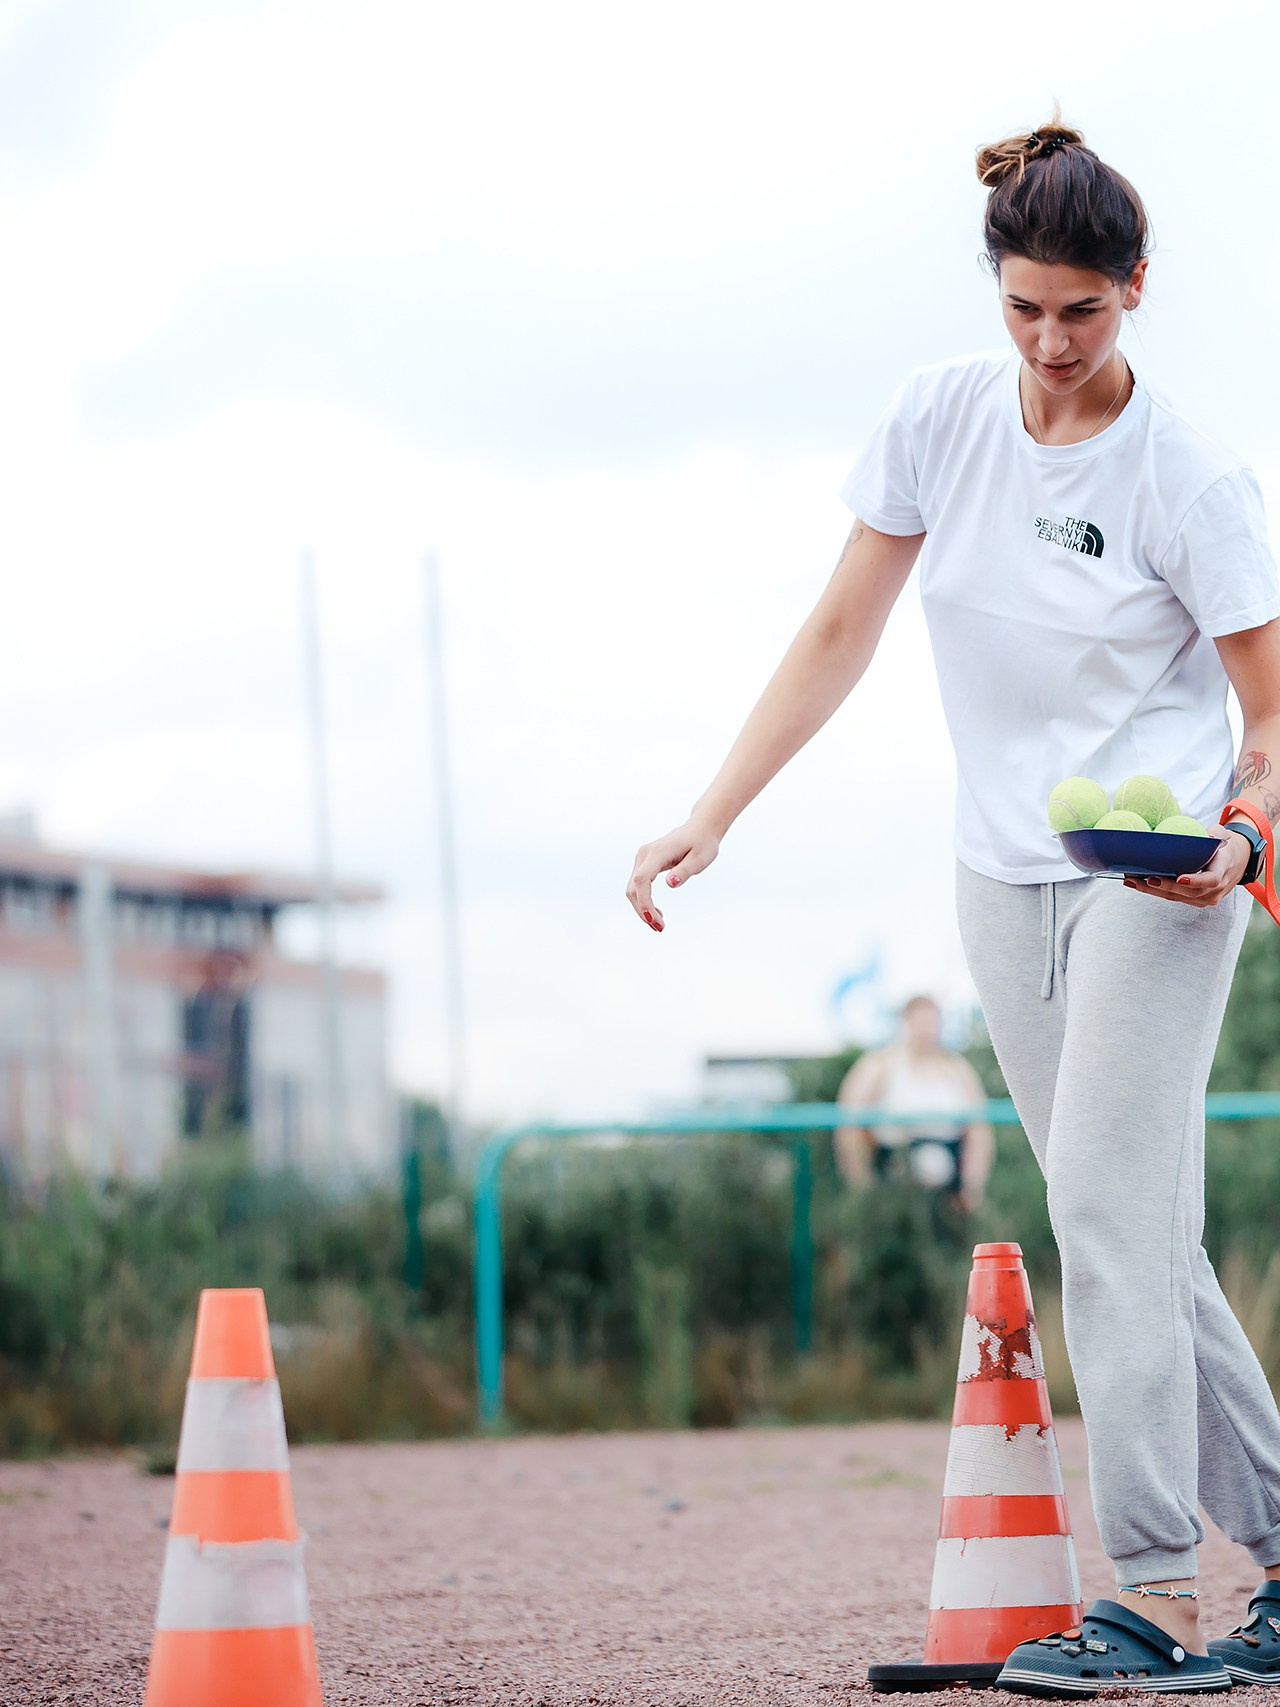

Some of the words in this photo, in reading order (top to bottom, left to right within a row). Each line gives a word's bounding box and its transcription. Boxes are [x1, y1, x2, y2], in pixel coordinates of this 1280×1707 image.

[1034, 517, 1084, 541] SEVERNYI
[1064, 516, 1087, 532] THE
[1037, 528, 1080, 552] EBALNIK
